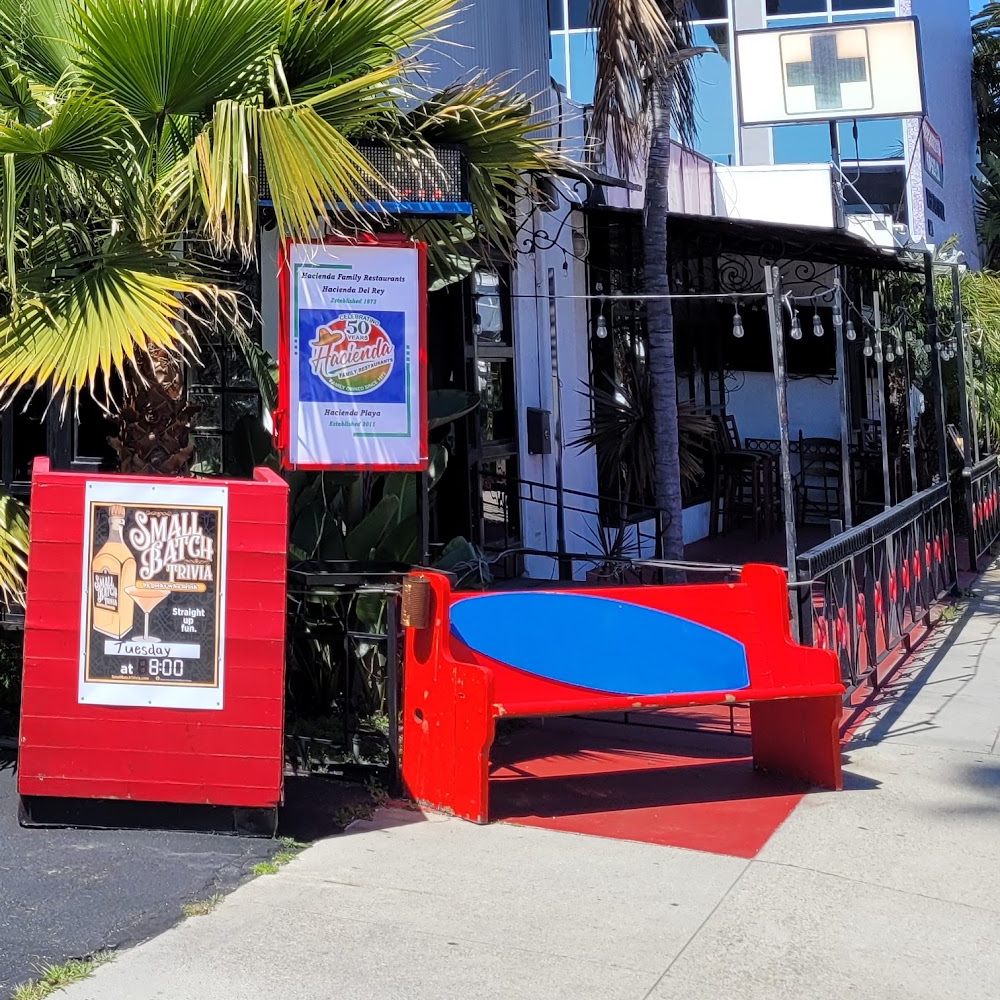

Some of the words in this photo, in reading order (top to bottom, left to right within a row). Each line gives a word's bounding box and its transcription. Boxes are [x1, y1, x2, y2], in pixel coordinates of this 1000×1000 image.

[301, 272, 335, 280] Hacienda
[337, 273, 361, 282] Family
[363, 274, 405, 282] Restaurants
[372, 287, 385, 296] Rey
[340, 314, 379, 326] CELEBRATING
[346, 319, 369, 334] 50
[312, 339, 393, 374] Hacienda
[339, 369, 357, 378] FAMILY
[358, 358, 393, 373] RESTAURANTS
[360, 410, 381, 418] Playa
[129, 511, 204, 551] SMALL
[139, 535, 214, 580] BATCH
[166, 563, 214, 582] TRIVIA
[95, 574, 114, 591] SMALL
[172, 607, 205, 617] Straight
[181, 625, 197, 633] fun.
[114, 641, 171, 657] Tuesday
[120, 664, 133, 674] at
[149, 659, 184, 676] 8:00
